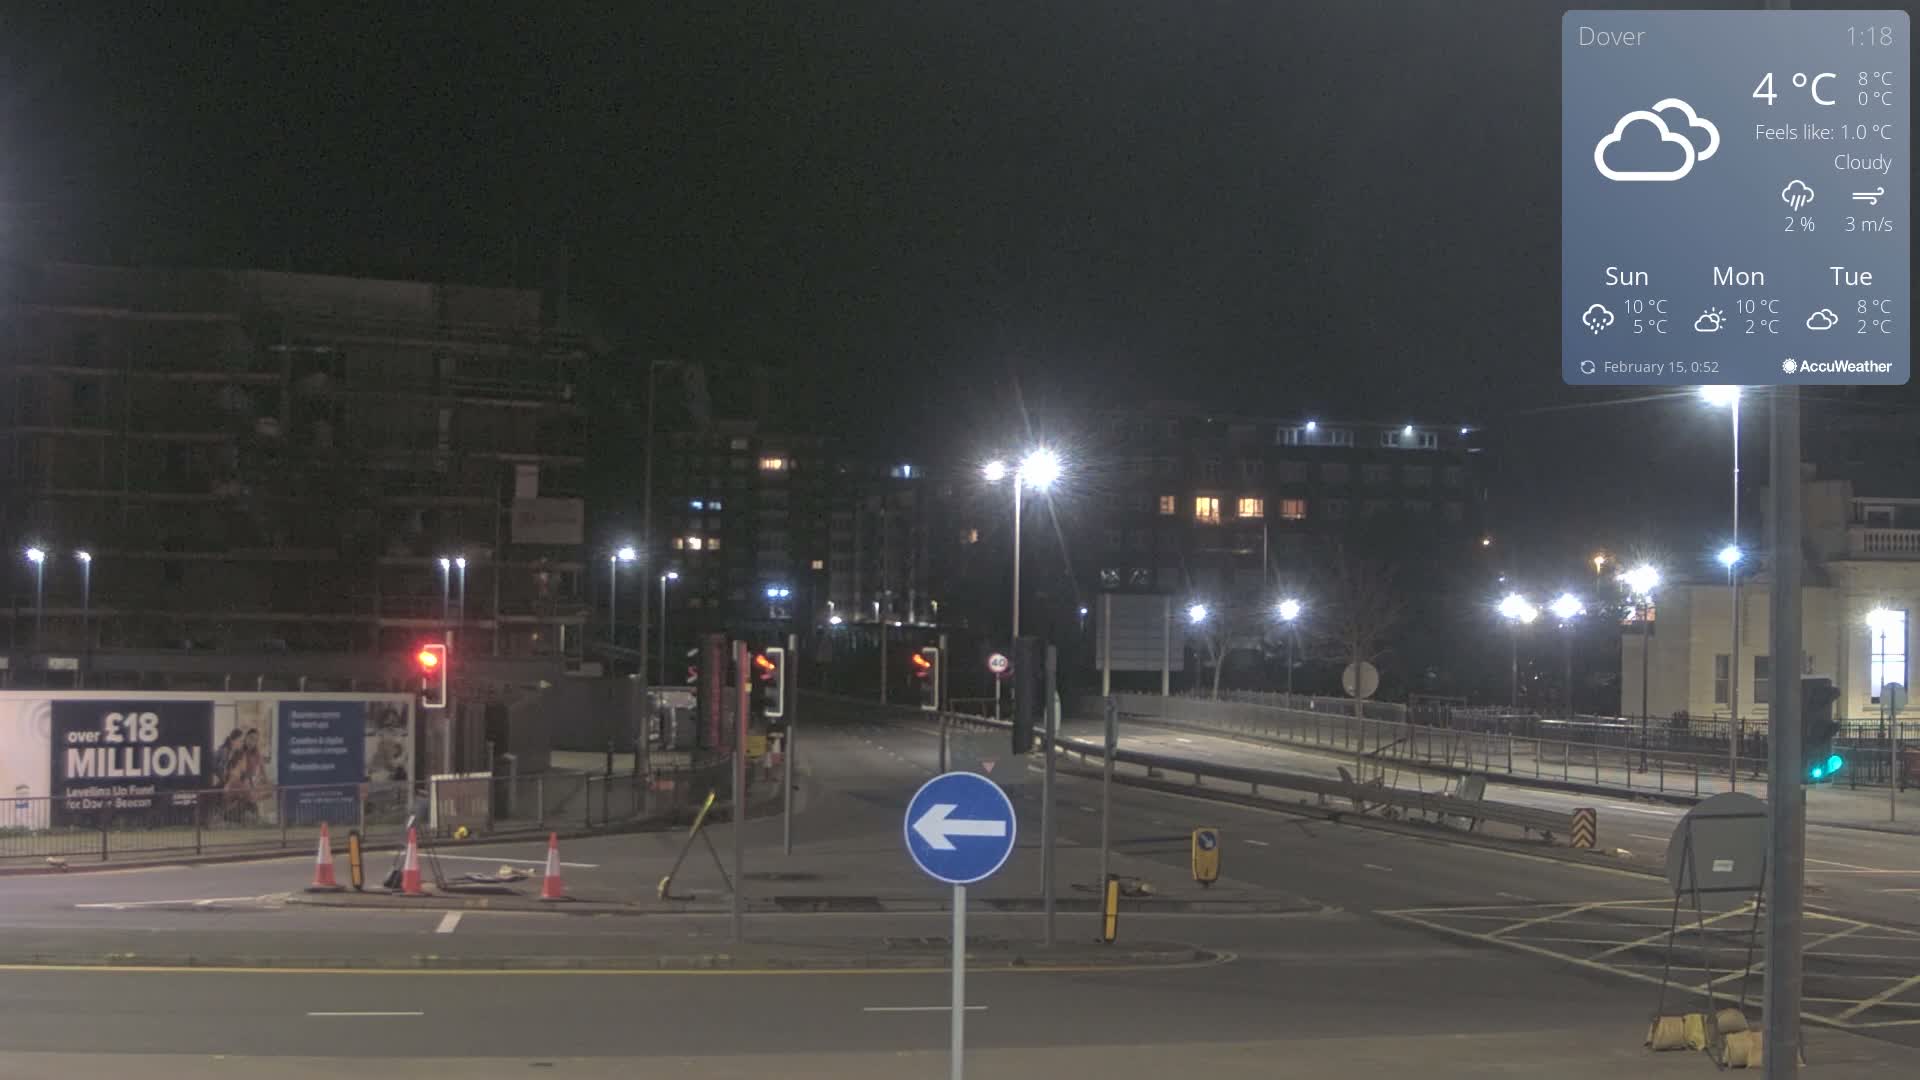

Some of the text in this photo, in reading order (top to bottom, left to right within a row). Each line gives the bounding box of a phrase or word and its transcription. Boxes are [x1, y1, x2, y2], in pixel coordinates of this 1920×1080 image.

[991, 658, 1006, 667] 40
[67, 712, 160, 743] over £18
[66, 745, 201, 779] MILLION
